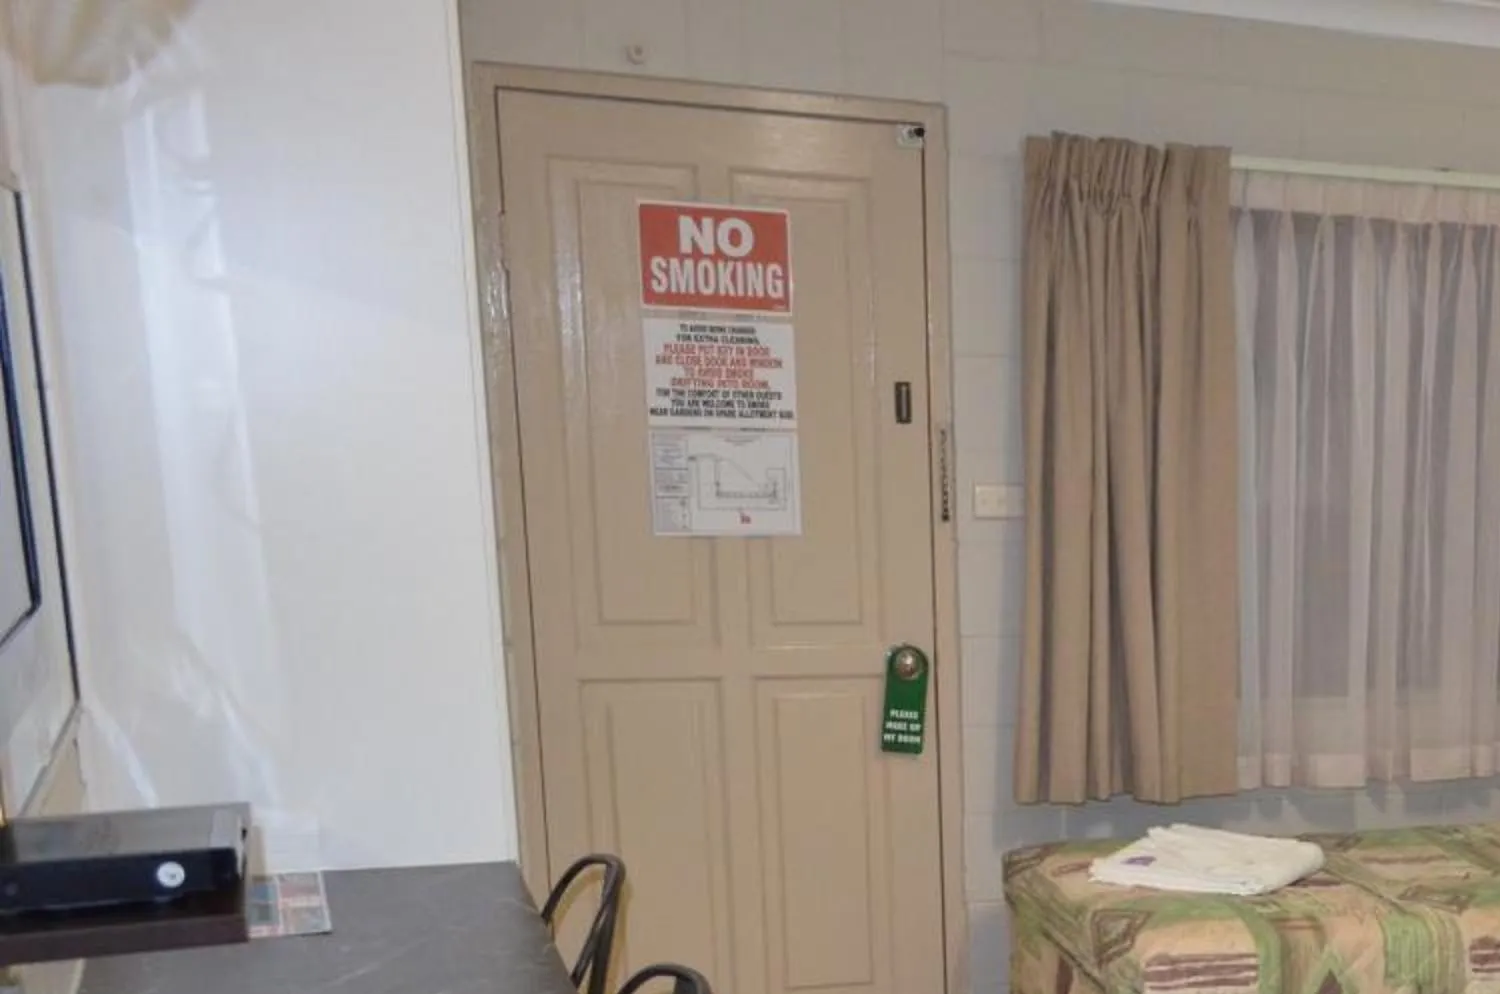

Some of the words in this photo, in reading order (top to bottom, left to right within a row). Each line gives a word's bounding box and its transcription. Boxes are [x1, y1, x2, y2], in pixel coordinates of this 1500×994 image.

[678, 214, 755, 258] NO
[650, 255, 785, 299] SMOKING
[663, 343, 697, 353] PLEASE
